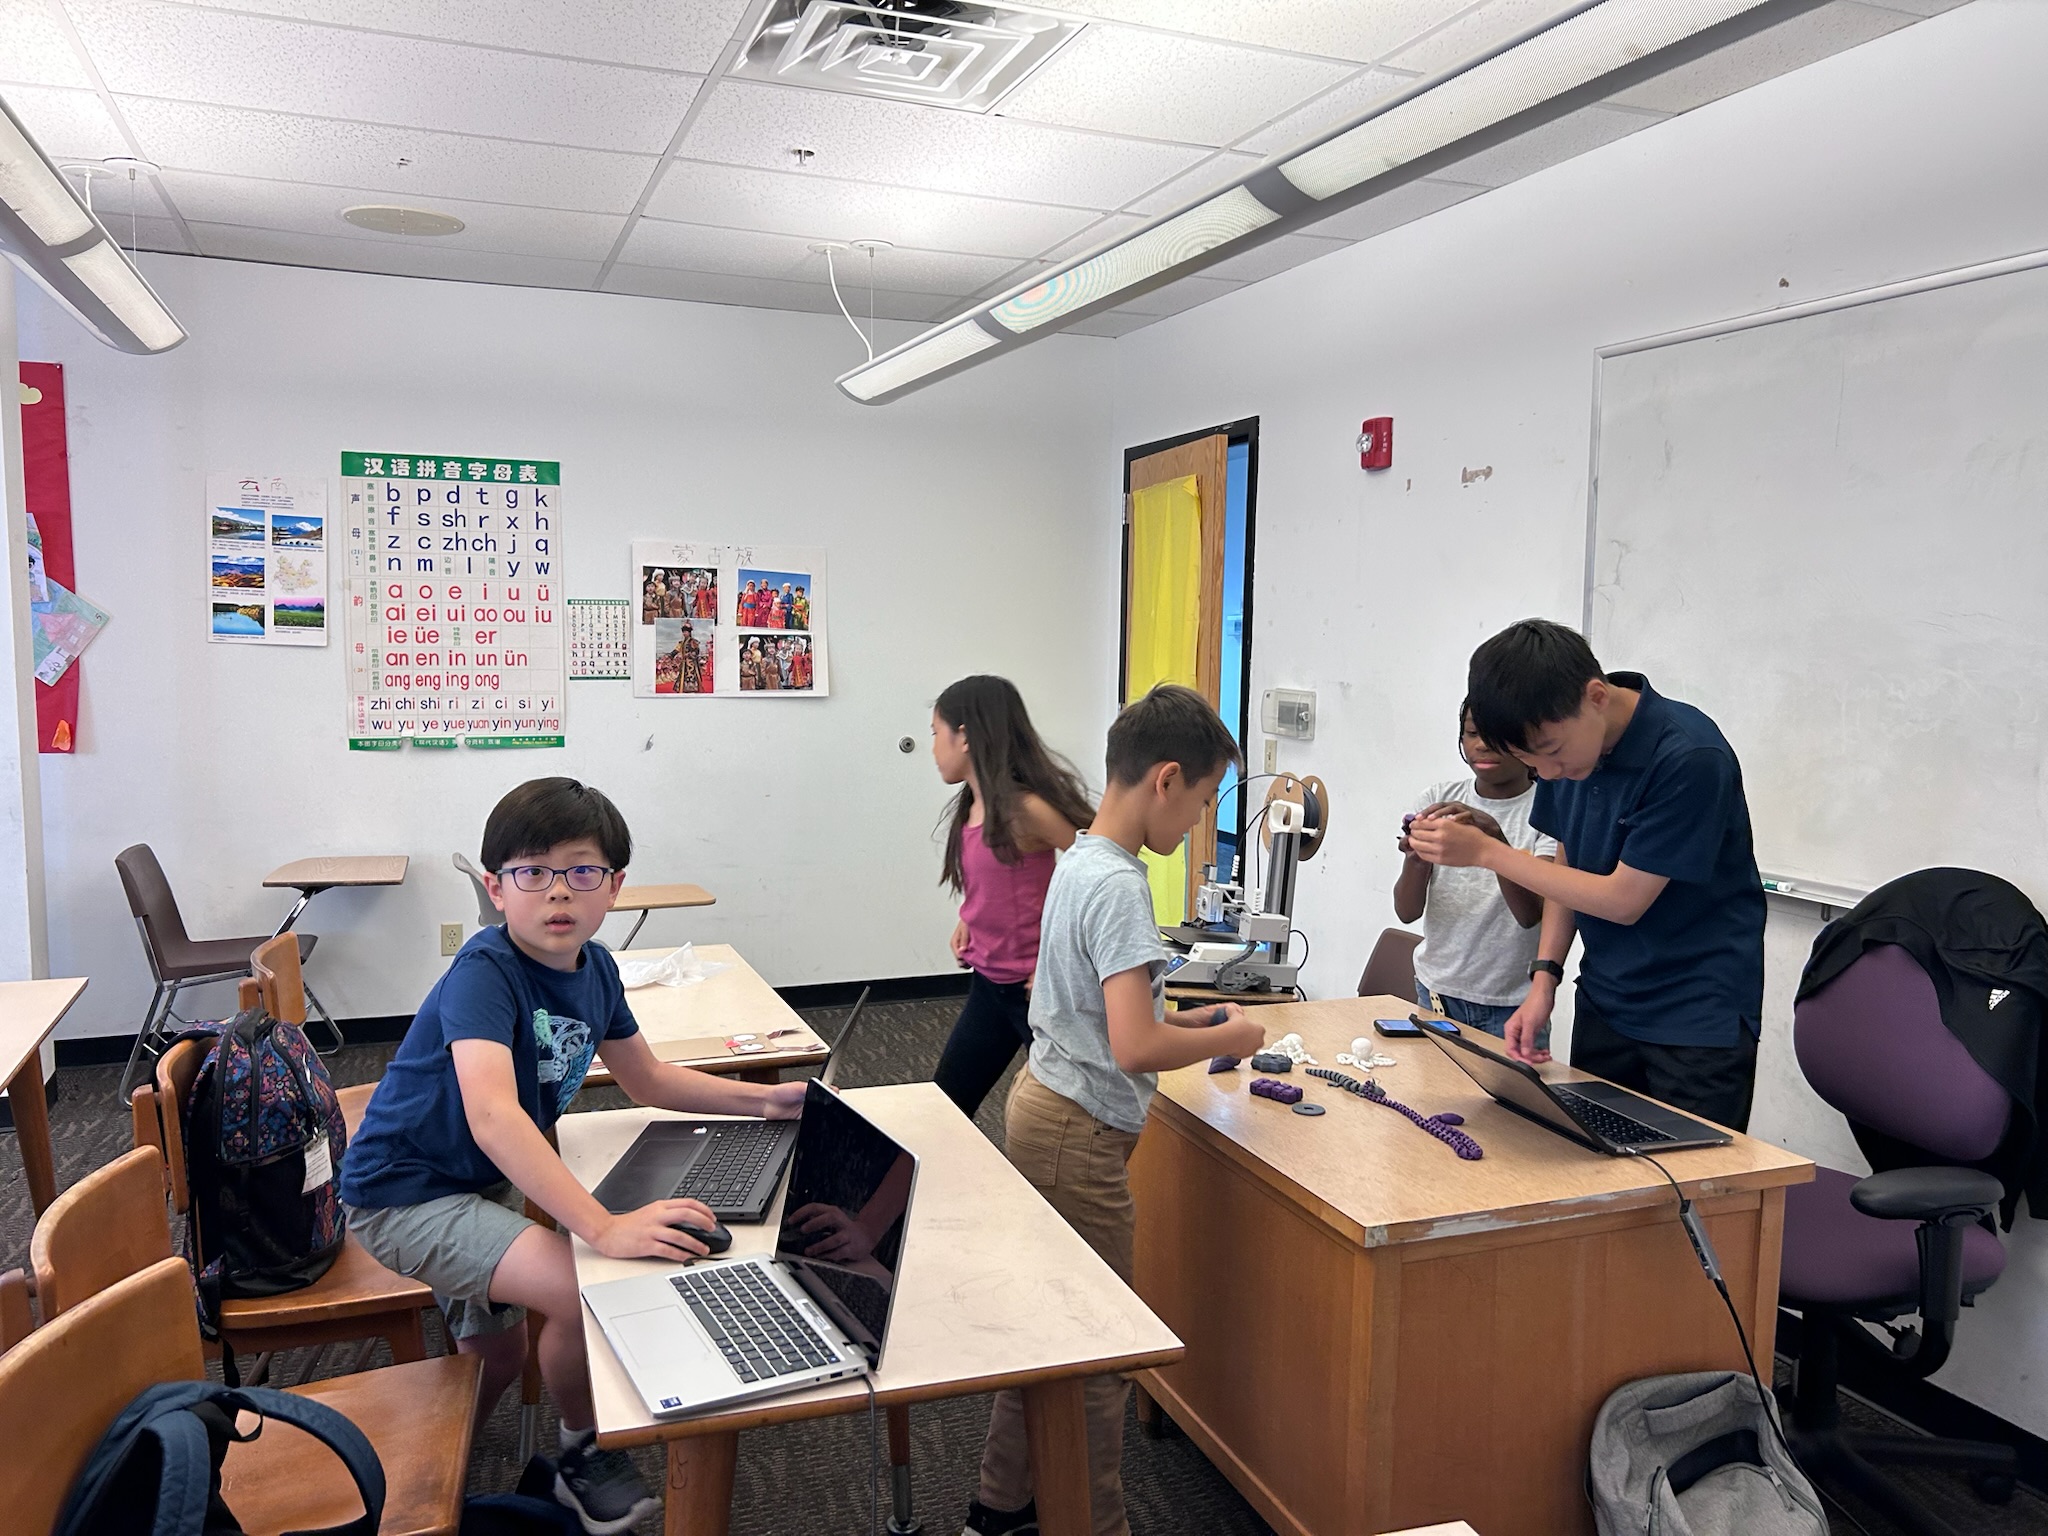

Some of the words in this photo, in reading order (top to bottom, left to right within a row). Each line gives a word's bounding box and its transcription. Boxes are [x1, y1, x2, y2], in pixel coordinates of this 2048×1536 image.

[364, 457, 538, 483] 汉语拼音字母表
[387, 482, 400, 501] b
[418, 489, 431, 505] p
[447, 485, 459, 504] d
[476, 488, 489, 505] t
[506, 490, 517, 508] g
[536, 488, 547, 507] k
[387, 506, 400, 525] f
[418, 513, 430, 526] s
[442, 508, 466, 527] sh
[479, 516, 489, 528] r
[507, 517, 518, 529] x
[536, 512, 548, 530] h
[388, 536, 400, 548] z
[418, 537, 431, 549] c
[443, 532, 466, 551] zh
[472, 533, 496, 551] ch
[508, 534, 515, 554] j
[536, 539, 548, 555] q
[388, 558, 401, 570] n
[418, 559, 432, 571] m
[508, 562, 520, 577] y
[536, 562, 549, 574] w
[389, 585, 402, 598] a
[420, 585, 432, 599] o
[449, 586, 461, 599] e
[484, 583, 487, 600] i
[508, 588, 519, 600] u
[538, 585, 549, 601] ü
[386, 604, 405, 620] ai
[417, 604, 435, 621] ei
[448, 605, 464, 621] ui
[474, 609, 497, 622] ao
[504, 609, 525, 622] ou
[536, 606, 551, 622] iu
[388, 626, 407, 643] ie
[416, 627, 439, 643] üe
[476, 631, 496, 644] er
[386, 653, 408, 666] an
[416, 653, 439, 666] en
[449, 650, 465, 666] in
[476, 654, 497, 666] un
[505, 650, 527, 666] ün
[385, 675, 410, 690] ang
[416, 675, 440, 690] eng
[447, 672, 469, 690] ing
[475, 675, 499, 690] ong
[371, 698, 391, 710] zhi
[395, 698, 415, 710] chi
[420, 697, 440, 710] shi
[449, 697, 458, 710] ri
[472, 697, 485, 709] zi
[495, 697, 507, 709] ci
[519, 697, 531, 709] si
[542, 697, 554, 711] yi
[372, 721, 391, 729] wu
[398, 721, 414, 732] yu
[423, 721, 438, 732] ye
[444, 721, 464, 731] yue
[468, 720, 489, 731] yuan
[493, 720, 511, 731] yin
[515, 720, 535, 730] yun
[538, 720, 558, 730] ying
